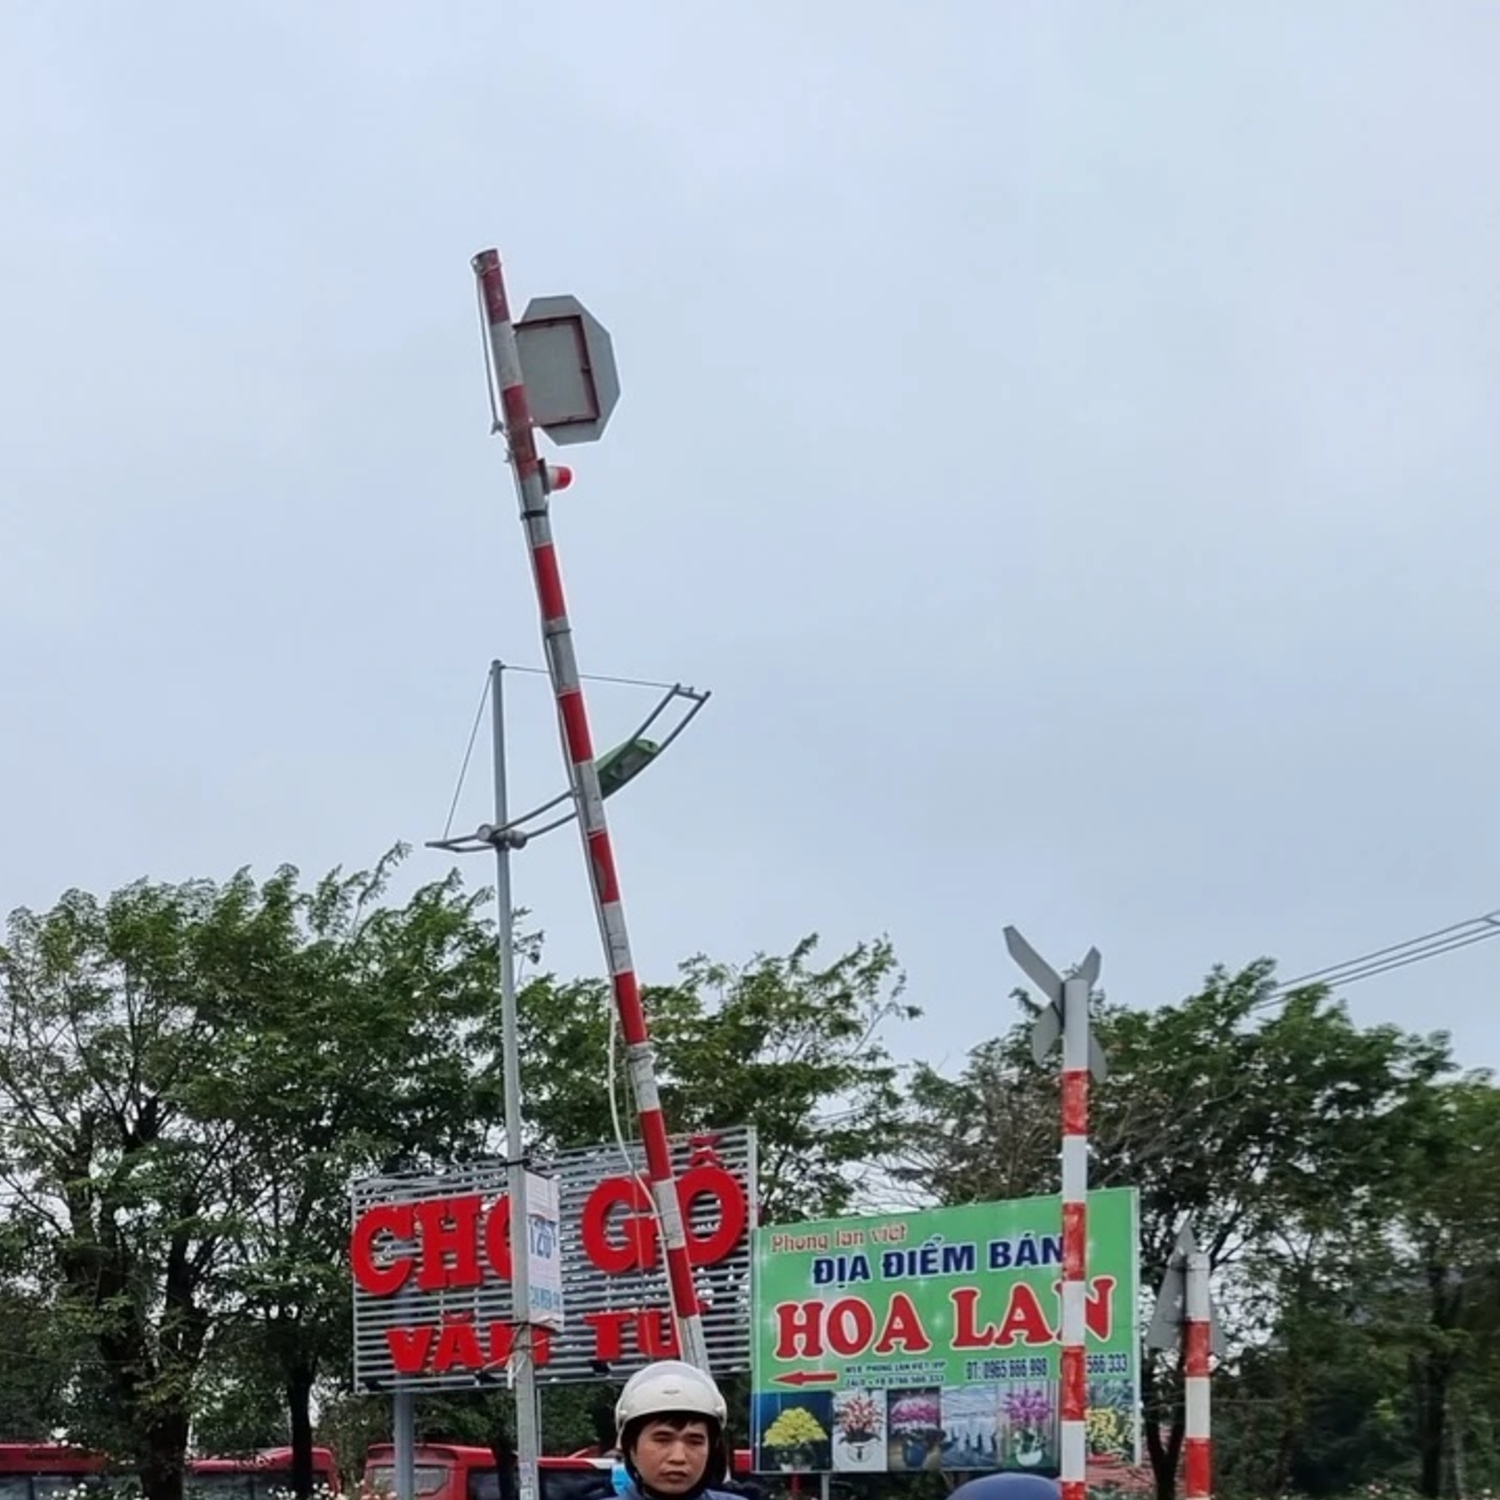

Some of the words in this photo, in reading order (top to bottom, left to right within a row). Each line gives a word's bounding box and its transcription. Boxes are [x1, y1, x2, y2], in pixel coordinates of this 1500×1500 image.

[772, 1234, 829, 1253] Phong
[836, 1229, 864, 1246] lan
[812, 1254, 871, 1289] ĐỊA
[882, 1236, 975, 1279] ĐIỂM
[988, 1232, 1063, 1269] BÁN
[773, 1293, 930, 1359] HOA
[950, 1277, 1115, 1348] LAN
